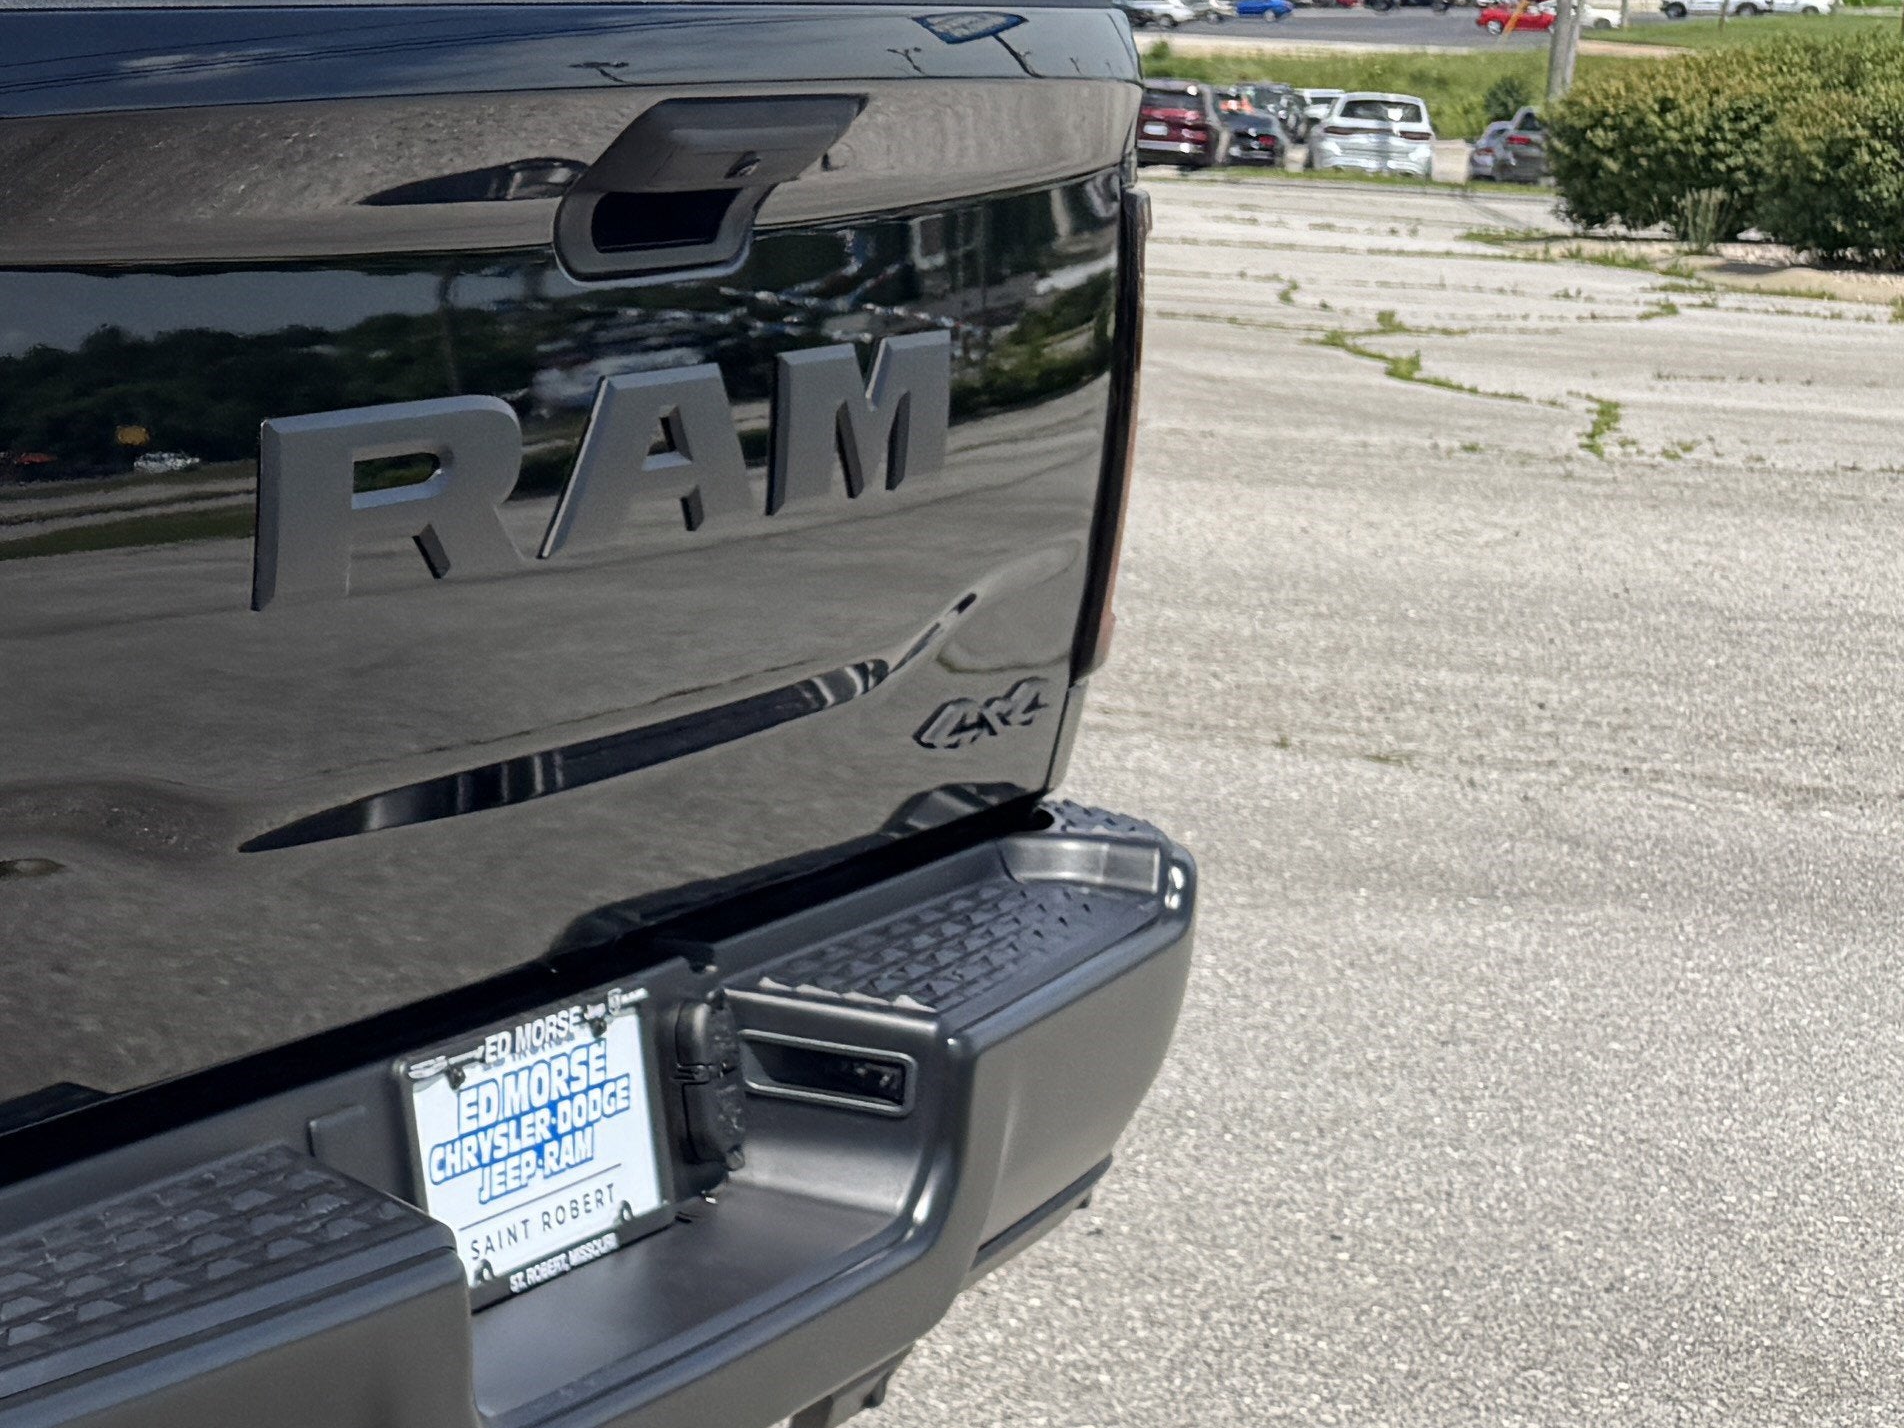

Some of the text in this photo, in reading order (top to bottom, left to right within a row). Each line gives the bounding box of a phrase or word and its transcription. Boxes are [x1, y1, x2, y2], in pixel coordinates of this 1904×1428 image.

[251, 329, 952, 612] RAM
[484, 1030, 512, 1064] ED
[515, 1005, 582, 1056] MORSE
[457, 1078, 499, 1138] ED
[501, 1037, 608, 1123] MORSE
[470, 1183, 614, 1260] SAINT ROBERT
